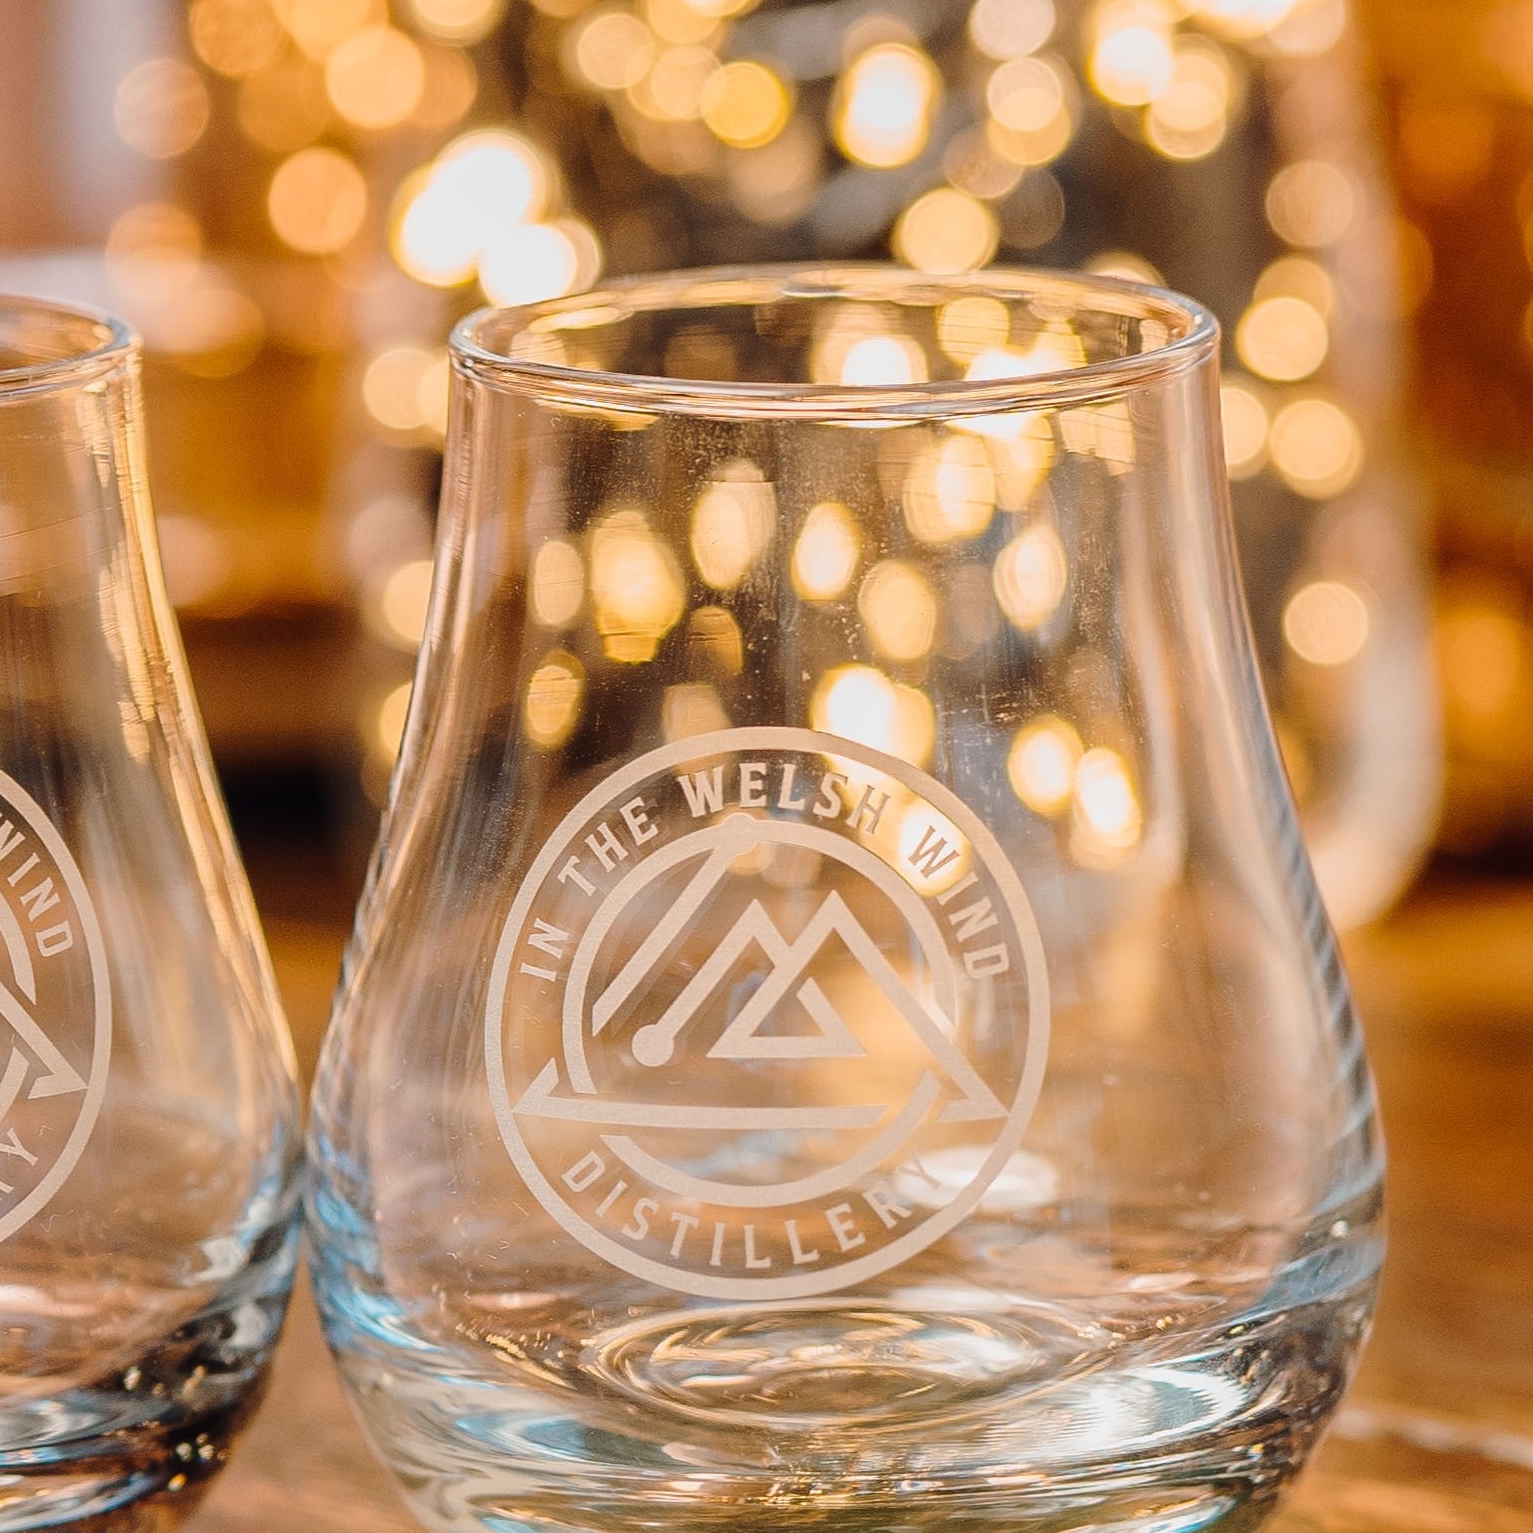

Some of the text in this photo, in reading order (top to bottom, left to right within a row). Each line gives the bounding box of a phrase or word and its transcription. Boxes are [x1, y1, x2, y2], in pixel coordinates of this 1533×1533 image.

[520, 762, 1010, 983] IN THE WELSH WIND
[562, 1151, 944, 1269] DISTILLERY
